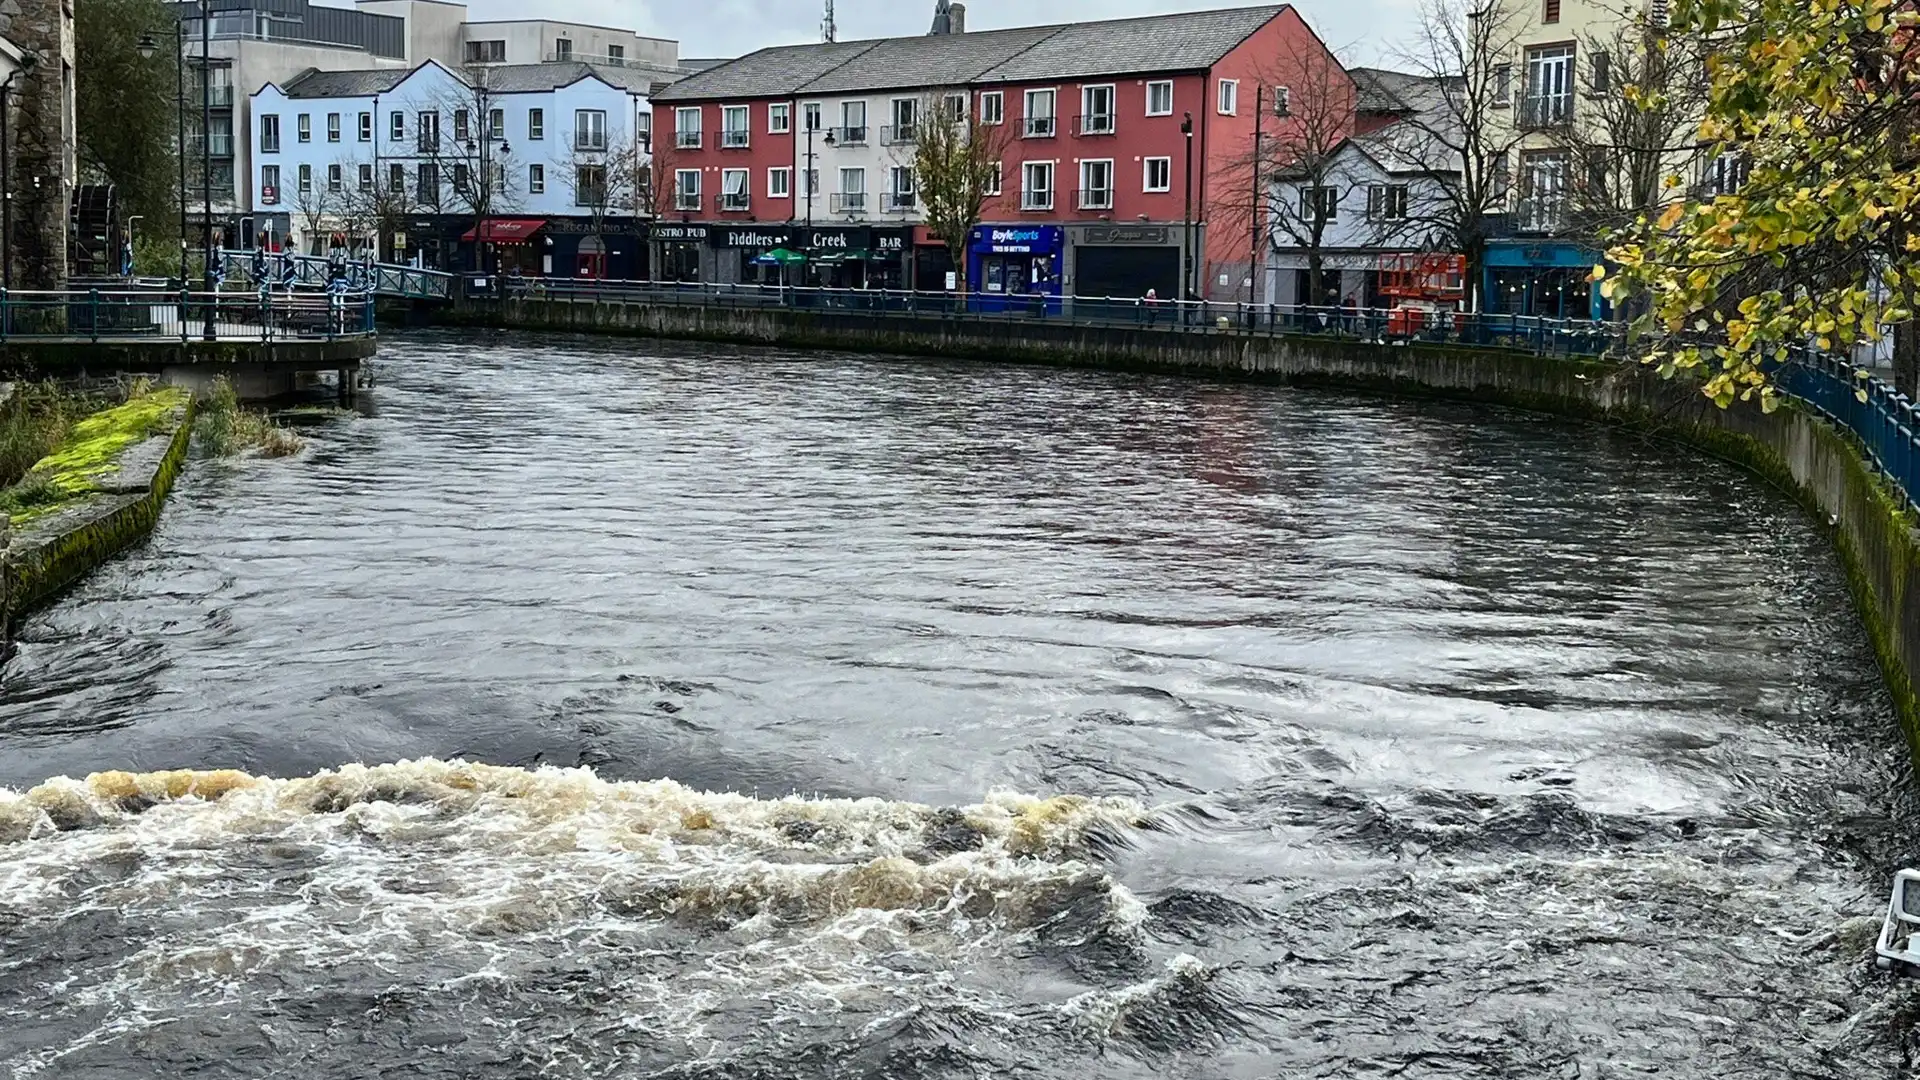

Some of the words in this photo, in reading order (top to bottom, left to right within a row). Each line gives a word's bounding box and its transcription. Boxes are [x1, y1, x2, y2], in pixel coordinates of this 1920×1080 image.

[687, 228, 706, 238] PUB
[992, 230, 1039, 243] BoyleSports
[728, 232, 773, 246] Fiddlers
[813, 232, 847, 248] Creek
[879, 237, 902, 248] BAR
